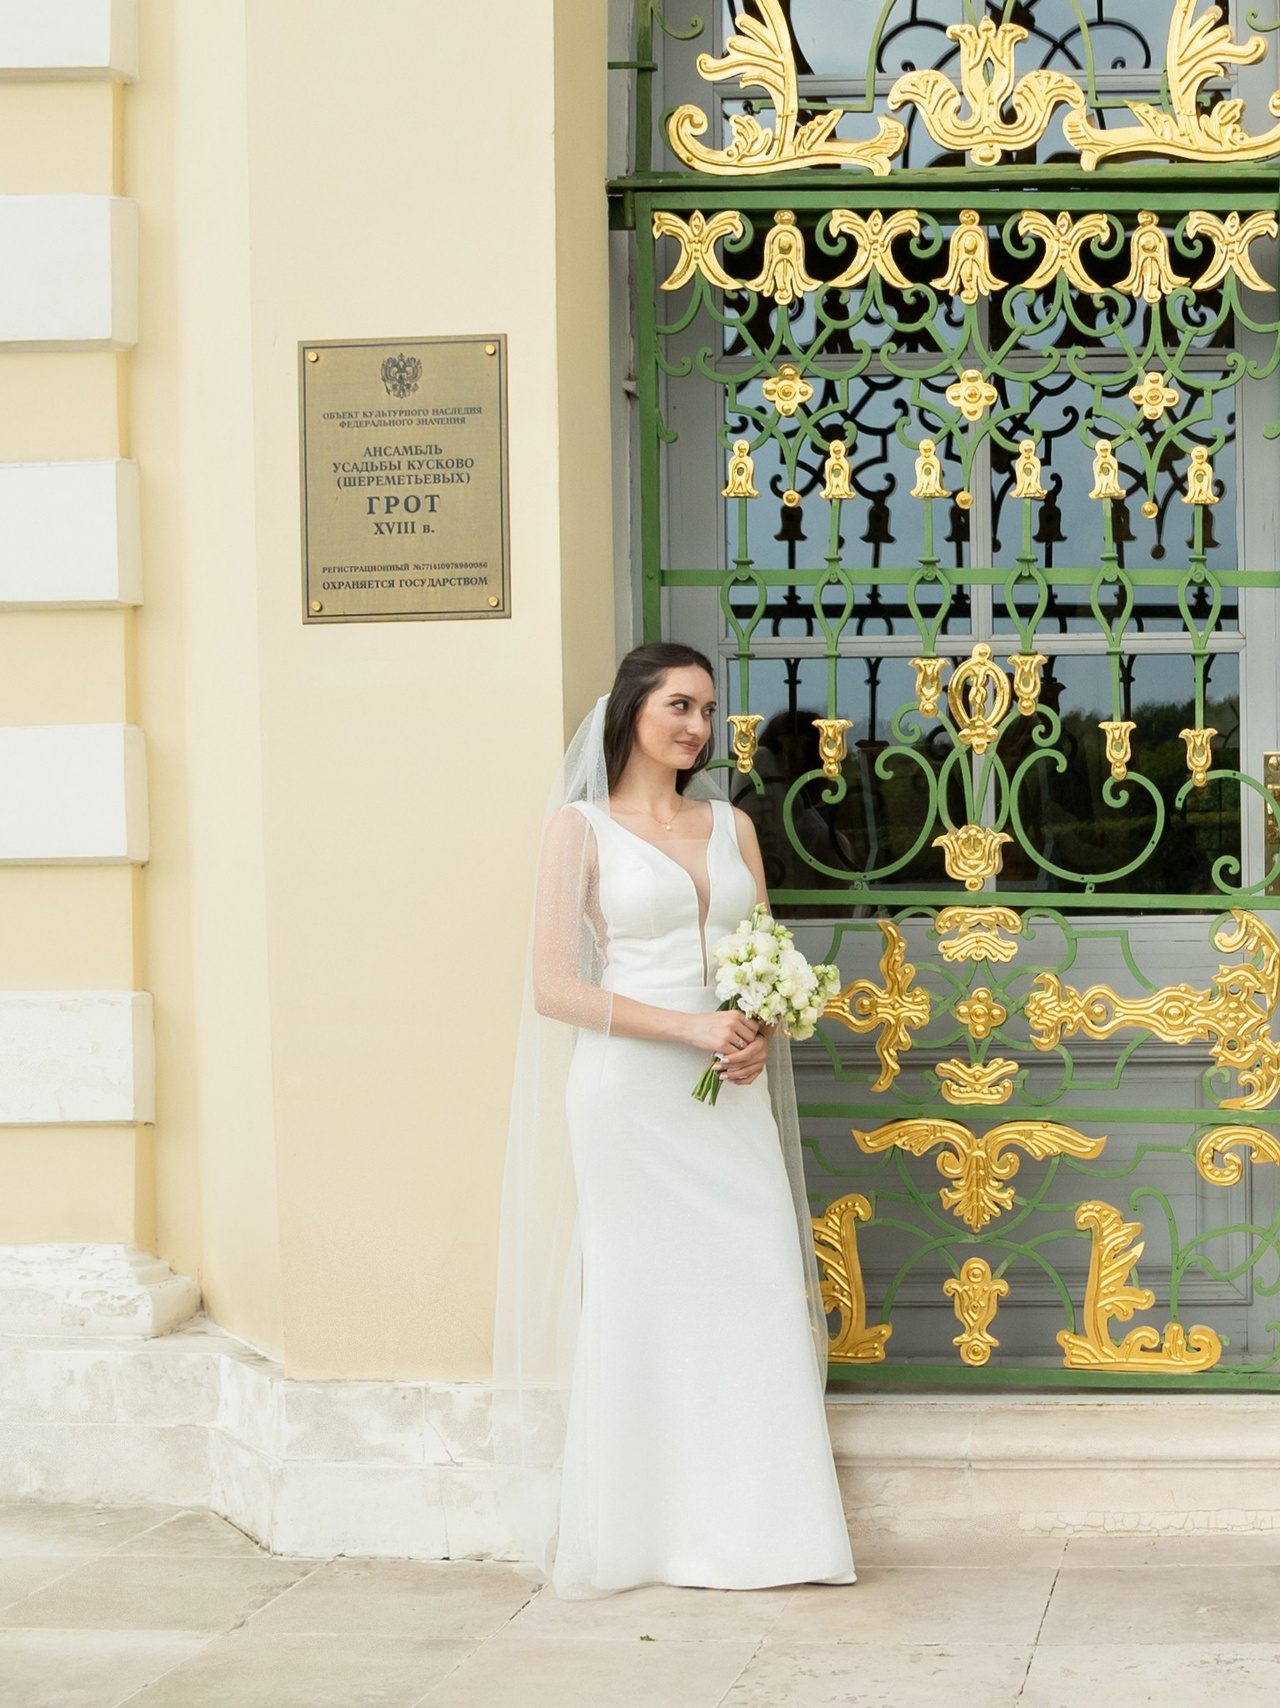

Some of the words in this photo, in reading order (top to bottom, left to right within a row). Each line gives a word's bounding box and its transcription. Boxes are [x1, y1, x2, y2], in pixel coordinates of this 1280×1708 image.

[322, 411, 360, 420] ОБЪЕКТ
[362, 408, 430, 417] КУЛЬТУРНОГО
[432, 407, 482, 416] НАСЛЕДИЯ
[339, 419, 414, 428] ФЕДЕРАЛЬНОГО
[416, 417, 466, 426] ЗНАЧЕНИЯ
[363, 445, 443, 457] АНСАМБЛЬ
[332, 460, 401, 474] УСАДЬБЫ
[407, 458, 474, 471] КУСКОВО
[337, 473, 470, 490] (ШЕРЕМЕТЬЕВЫХ)
[367, 495, 440, 514] ГРОТ
[374, 522, 416, 535] XVIII
[423, 524, 435, 533] в.
[322, 563, 409, 574] РЕГИСТРАЦИОННЫЙ
[322, 579, 395, 590] ОХРАНЯЕТСЯ
[399, 577, 488, 588] ГОСУДАРСТВОМ
